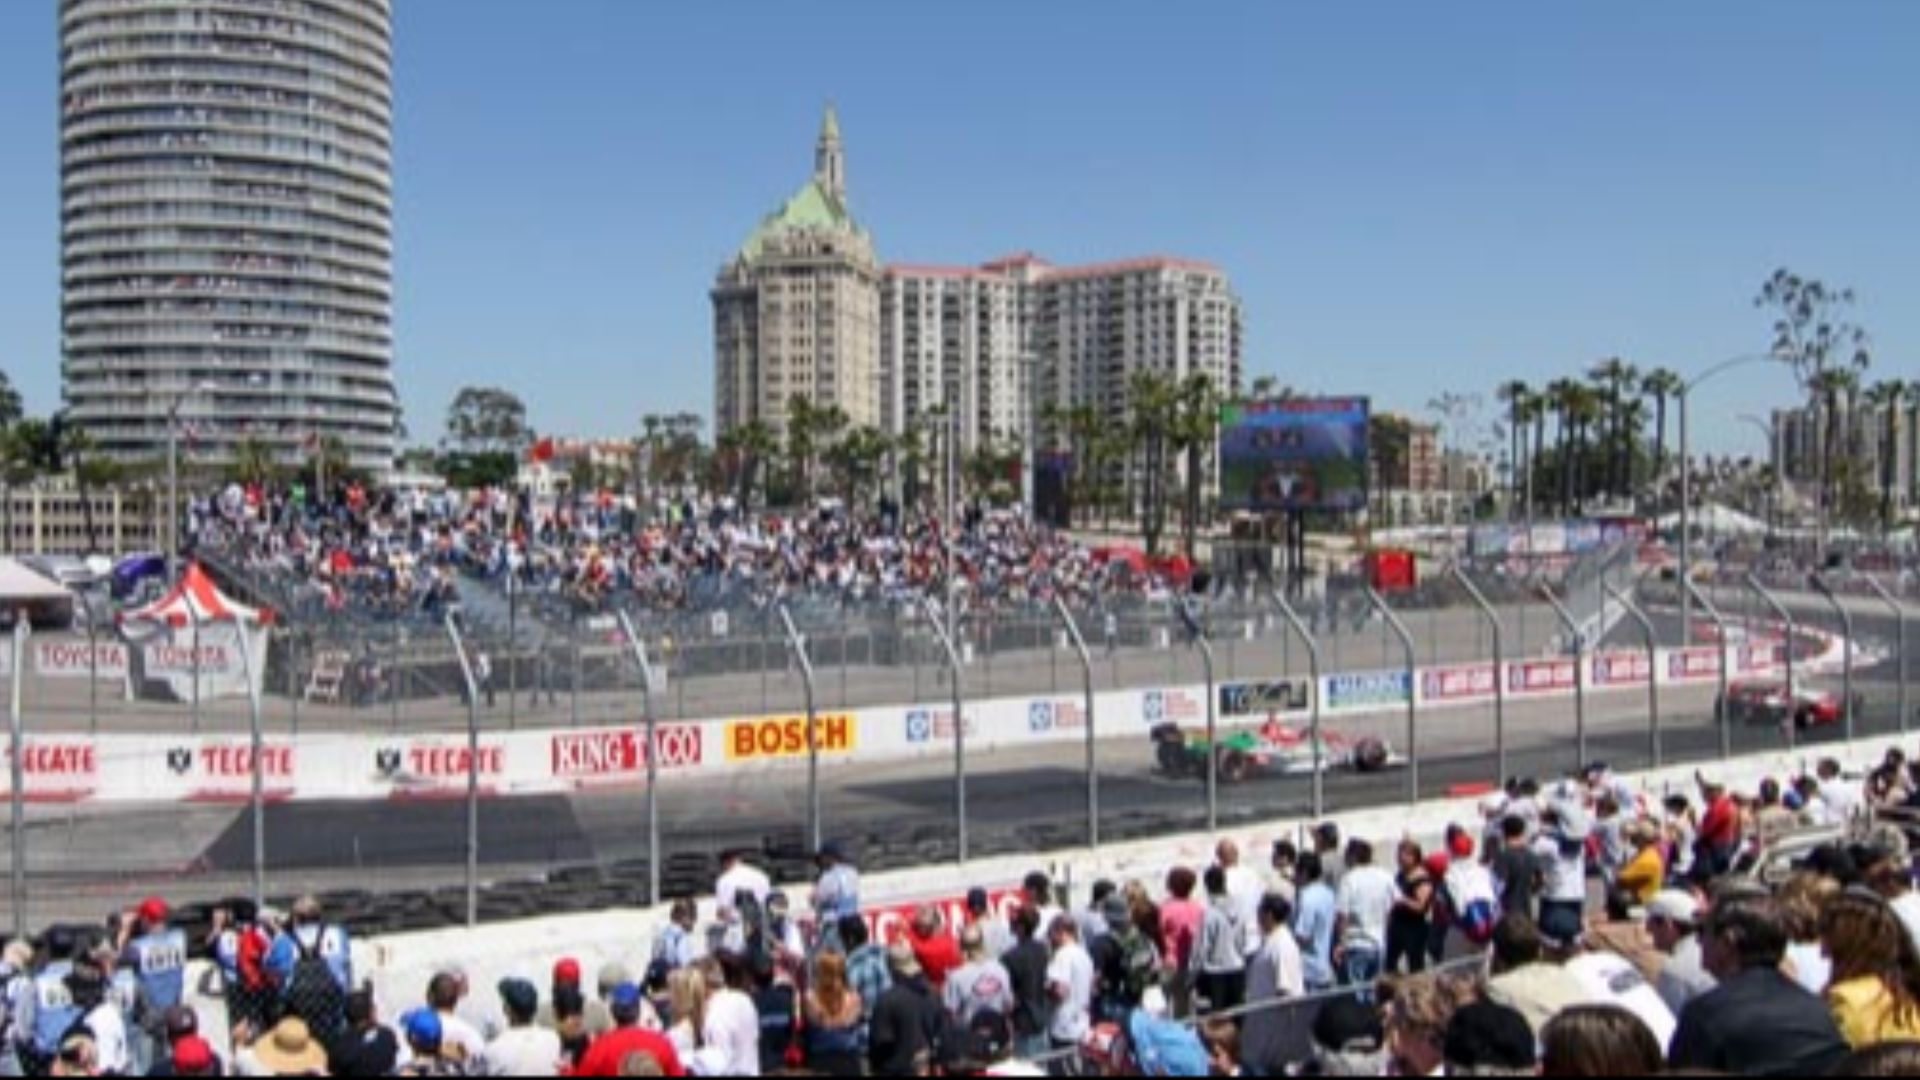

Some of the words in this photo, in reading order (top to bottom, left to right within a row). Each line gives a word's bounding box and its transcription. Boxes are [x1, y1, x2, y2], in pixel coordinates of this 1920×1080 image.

[41, 643, 123, 667] TOYOTA
[558, 733, 623, 773] KING
[734, 714, 847, 757] BOSCH
